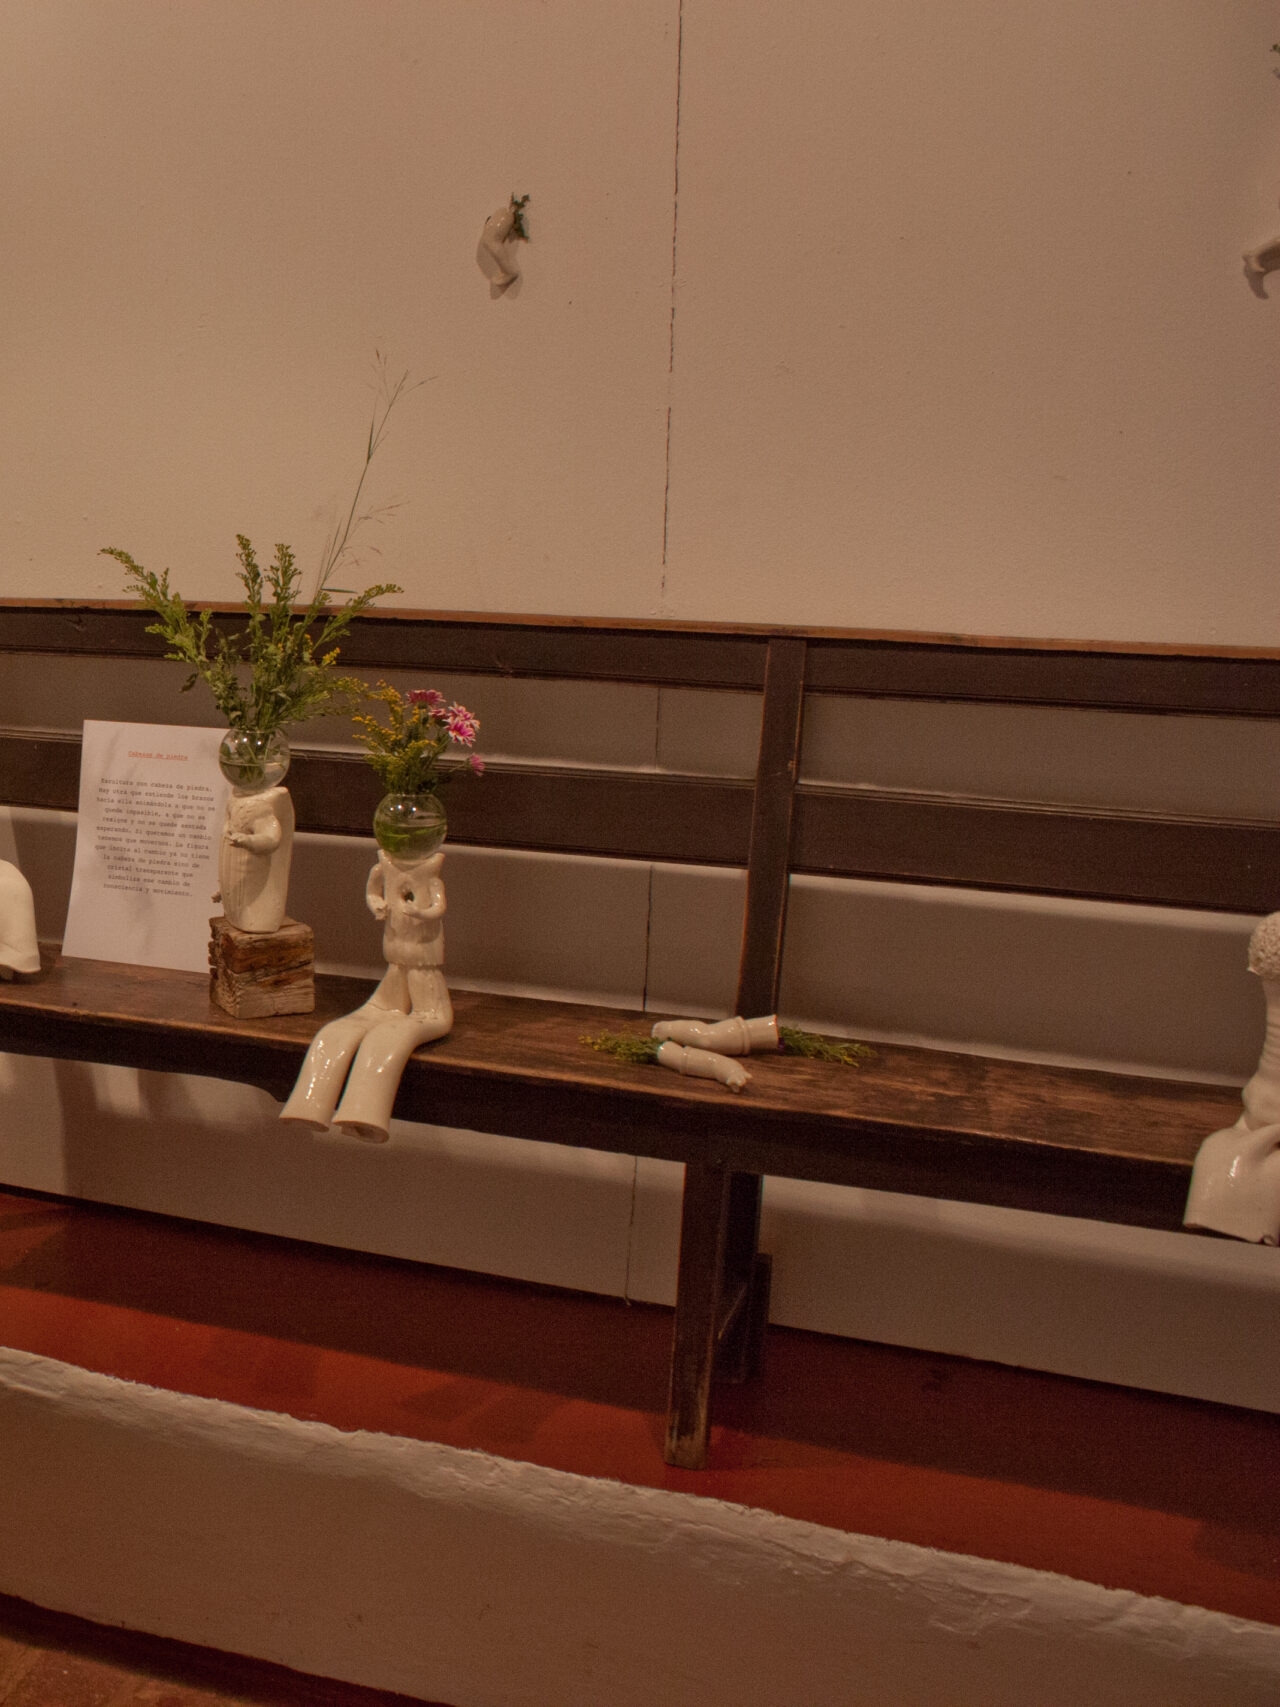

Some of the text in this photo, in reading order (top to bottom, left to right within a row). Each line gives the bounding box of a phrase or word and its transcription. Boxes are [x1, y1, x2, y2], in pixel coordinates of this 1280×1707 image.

[101, 778, 134, 786] Escultura
[98, 787, 109, 795] Hay
[186, 842, 209, 850] figura
[148, 858, 171, 866] piedra
[107, 864, 132, 872] cristal
[135, 867, 179, 876] transparente
[108, 874, 141, 882] simboliza
